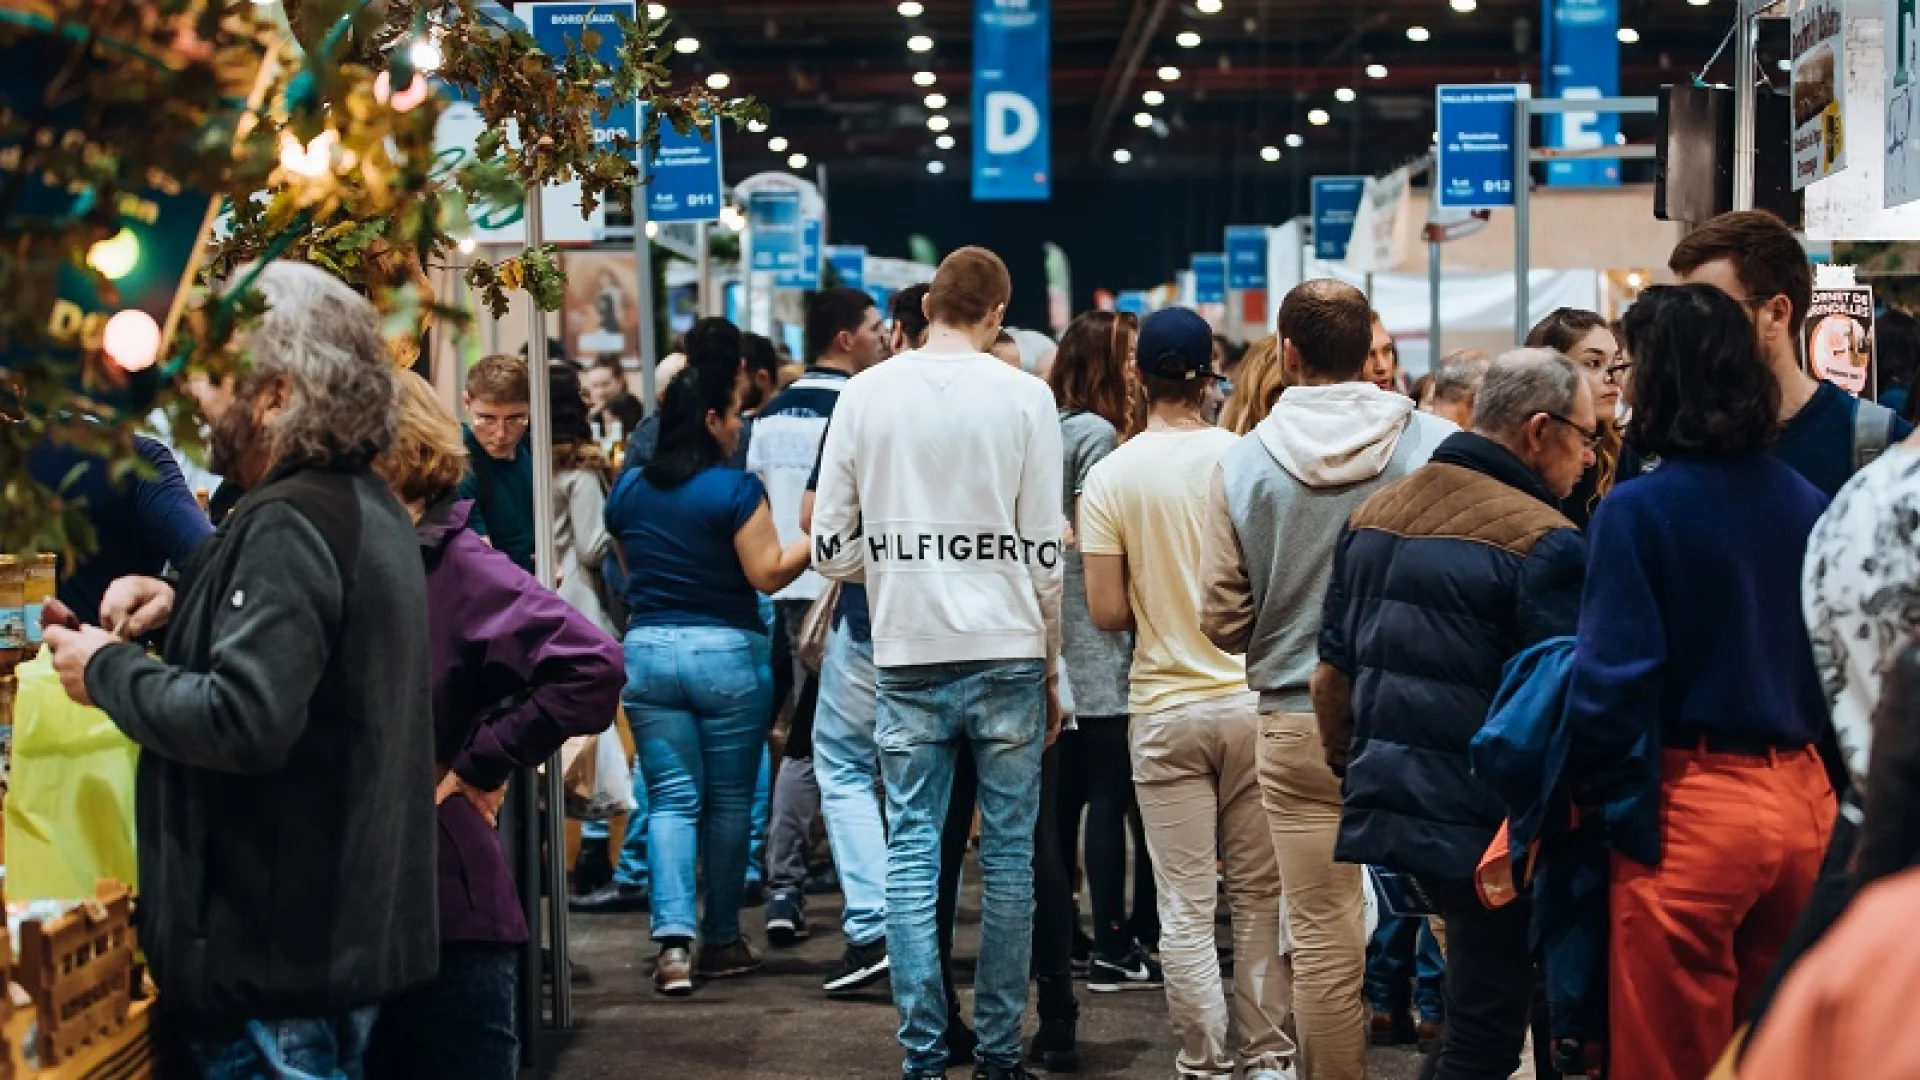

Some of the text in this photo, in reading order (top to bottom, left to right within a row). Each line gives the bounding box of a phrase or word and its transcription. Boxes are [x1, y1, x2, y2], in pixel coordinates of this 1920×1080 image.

[985, 91, 1040, 155] D
[1562, 86, 1603, 149] E
[1483, 179, 1512, 193] D12
[686, 193, 714, 206] D11
[1811, 292, 1851, 303] ORNET
